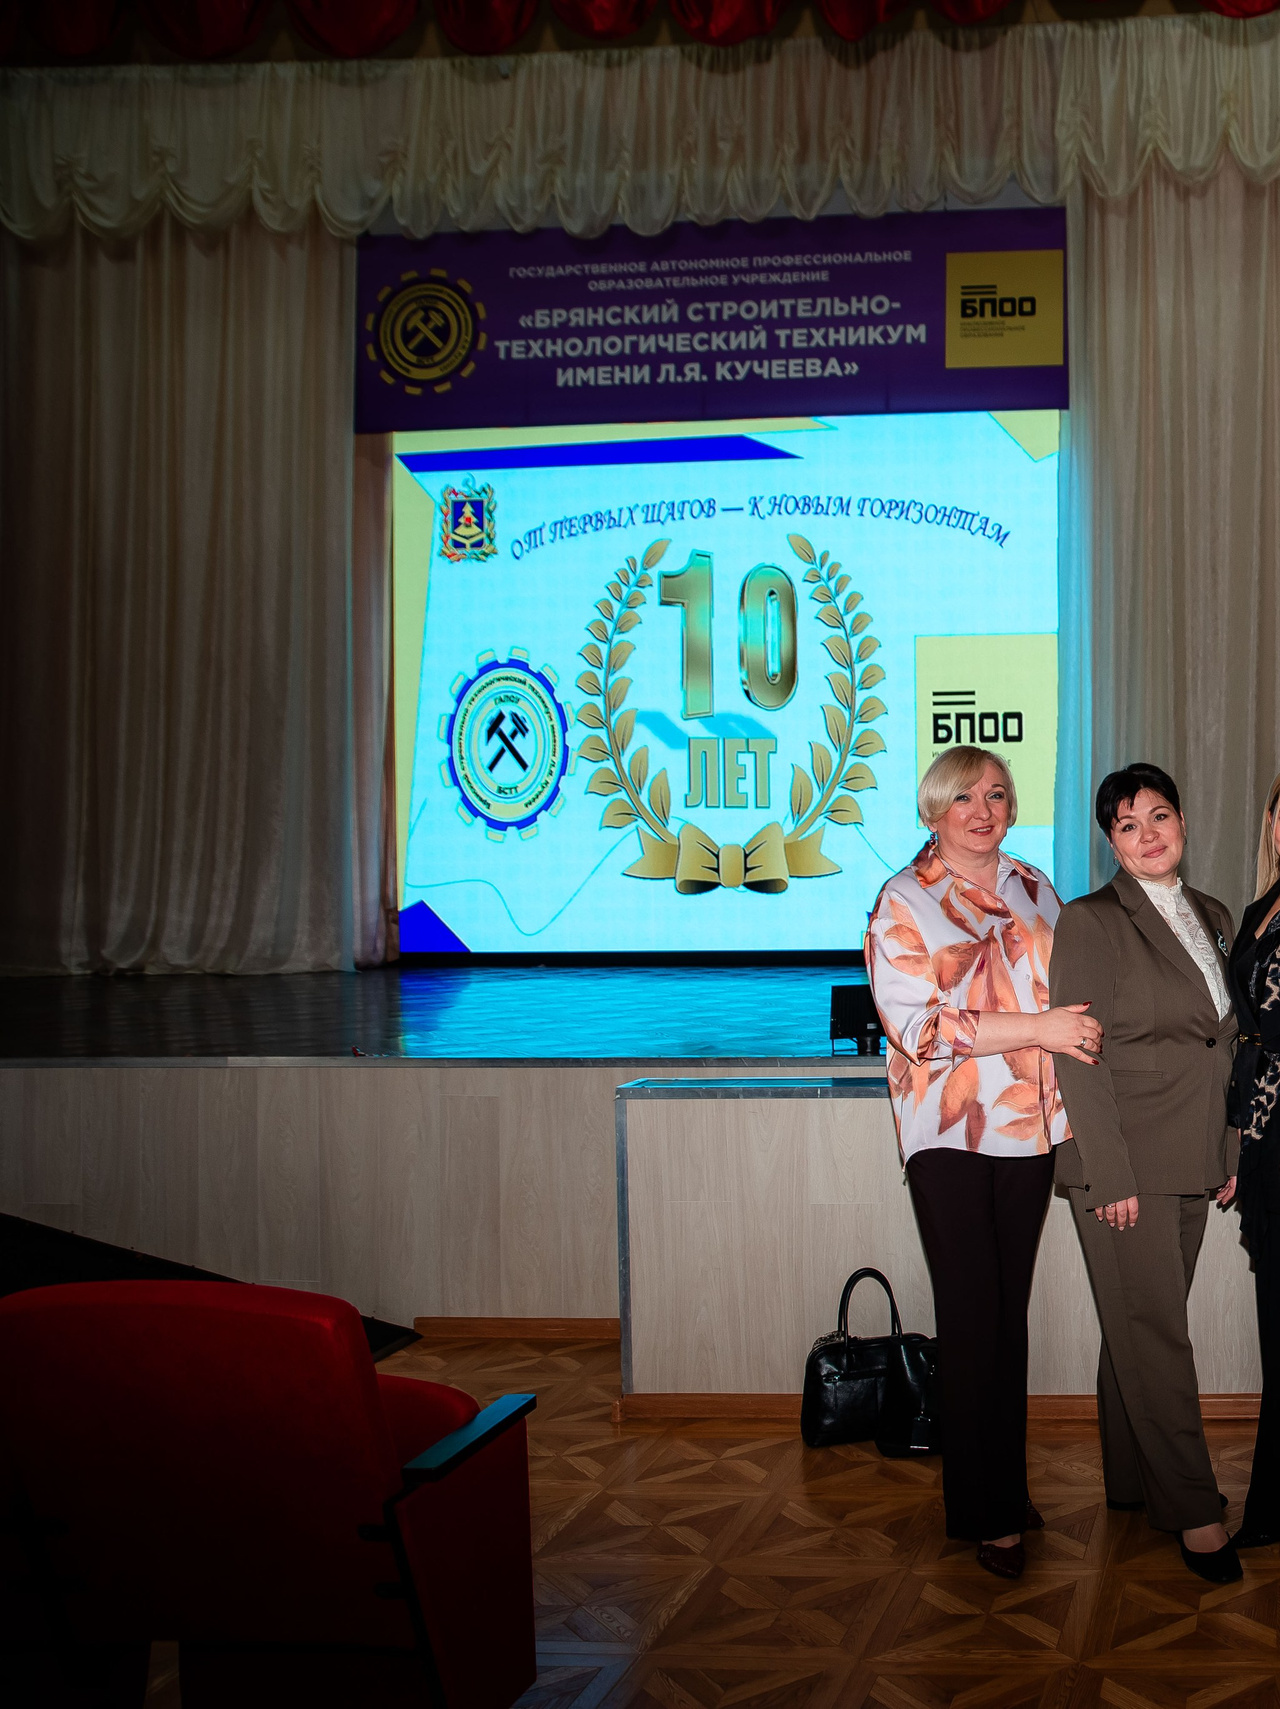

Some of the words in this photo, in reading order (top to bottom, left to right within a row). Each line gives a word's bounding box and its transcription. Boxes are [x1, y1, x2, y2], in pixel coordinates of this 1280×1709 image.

[509, 261, 648, 279] ГОСУДАРСТВЕННОЕ
[650, 256, 750, 273] АВТОНОМНОЕ
[752, 250, 913, 269] ПРОФЕССИОНАЛЬНОЕ
[587, 274, 729, 293] ОБРАЗОВАТЕЛЬНОЕ
[731, 269, 831, 286] УЧРЕЖДЕНИЕ
[518, 298, 680, 329] «БРЯНСКИЙ
[686, 294, 902, 323] СТРОИТЕЛЬНО-
[961, 296, 1036, 318] БПОО
[494, 324, 768, 360] ТЕХНОЛОГИЧЕСКИЙ
[775, 322, 928, 349] ТЕХНИКУМ
[556, 363, 651, 388] ИМЕНИ
[656, 361, 709, 384] Л.Я.
[715, 356, 859, 381] КУЧЕЕВА»
[510, 521, 547, 561] ОТ
[549, 502, 640, 544] ПЕРВЫХ
[641, 497, 717, 526] ШАГОВ
[748, 495, 767, 521] К
[767, 493, 852, 518] НОВЫМ
[856, 497, 1012, 549] ГОРИЗОНТАМ
[658, 549, 798, 720] 10
[932, 711, 1023, 744] БПОО
[684, 735, 778, 809] ЛЕТ
